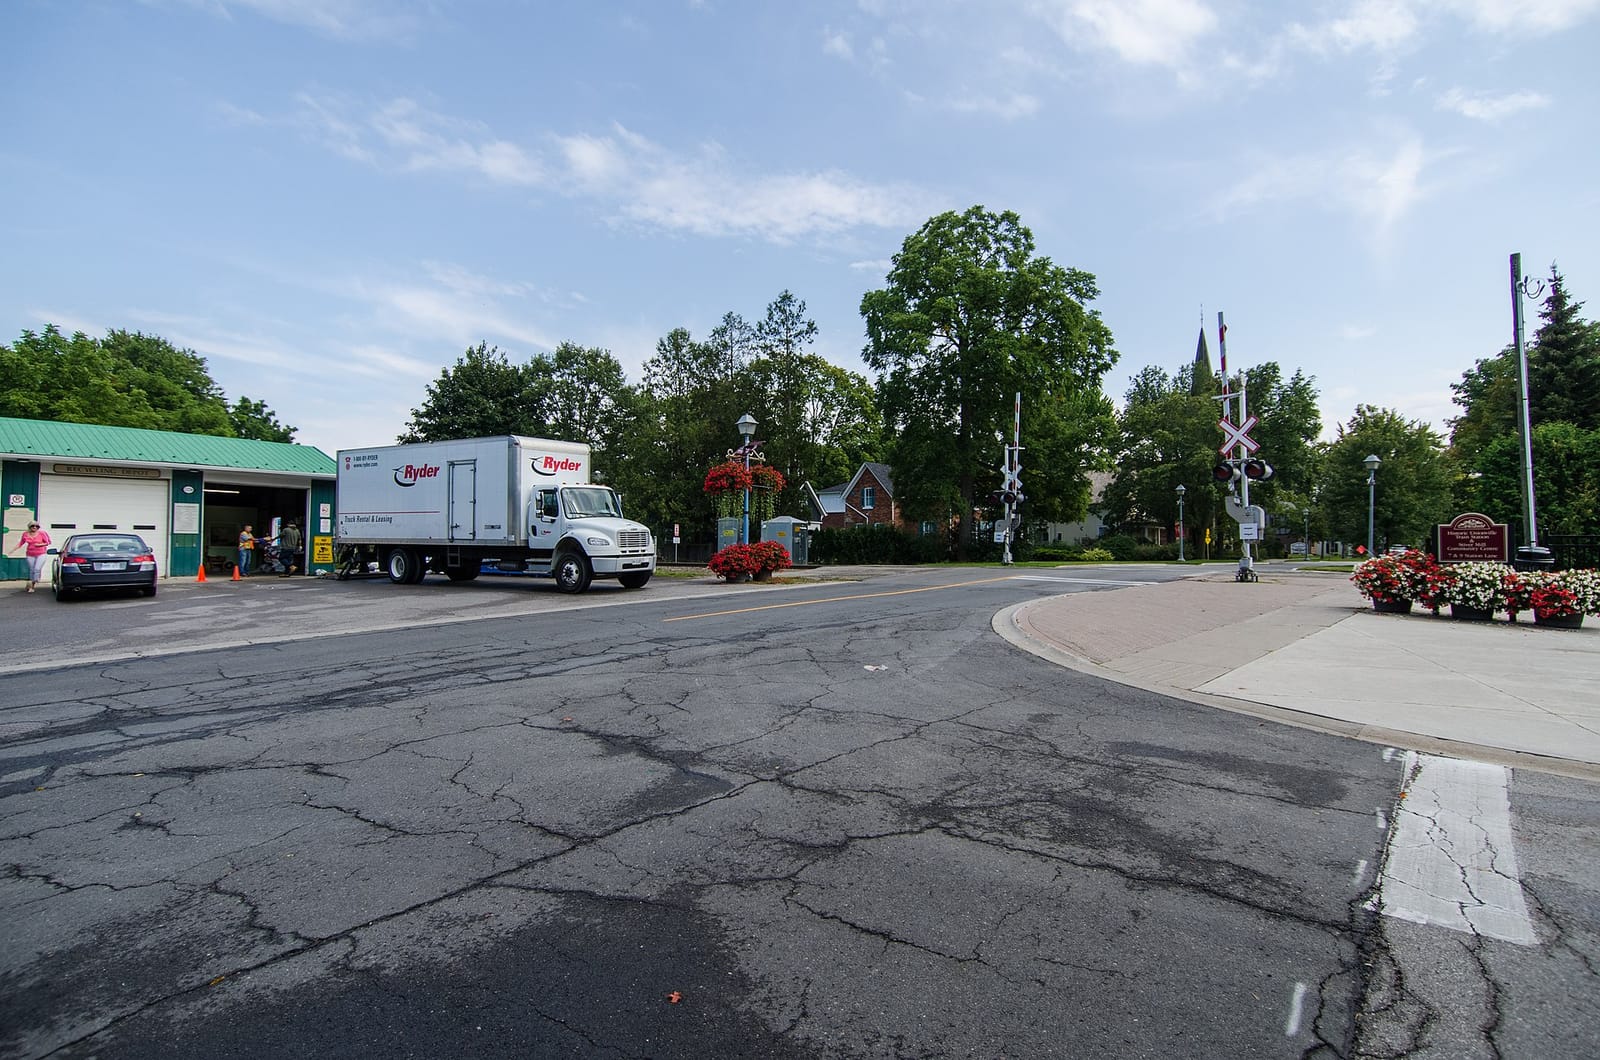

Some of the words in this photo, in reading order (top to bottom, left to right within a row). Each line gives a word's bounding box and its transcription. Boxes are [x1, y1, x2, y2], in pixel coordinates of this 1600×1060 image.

[66, 466, 117, 474] RECYCLING
[543, 455, 582, 472] Ryder
[404, 463, 440, 482] Ryder
[375, 515, 393, 524] Leasing
